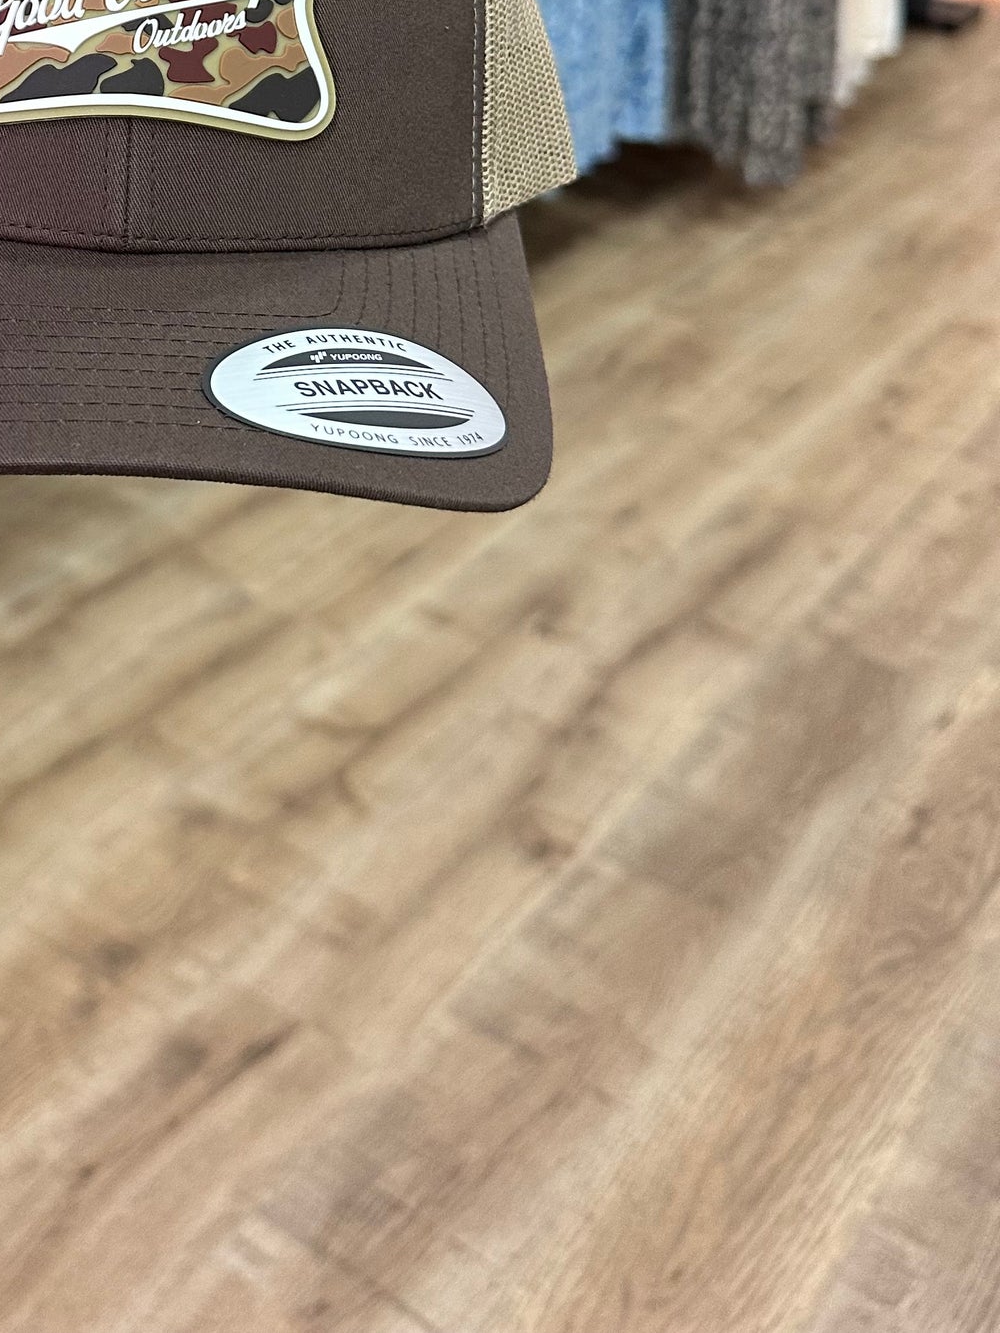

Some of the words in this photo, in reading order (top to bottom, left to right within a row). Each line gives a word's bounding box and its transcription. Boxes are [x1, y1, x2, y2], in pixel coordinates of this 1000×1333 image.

[132, 7, 248, 55] Outdoors
[262, 339, 296, 354] THE
[305, 333, 408, 353] AUTHENTIC
[329, 352, 383, 362] YUPOONG
[293, 379, 444, 401] SNAPBACK
[310, 423, 399, 445] YUPOONG
[408, 435, 452, 448] SINCE
[456, 431, 484, 446] 1974
